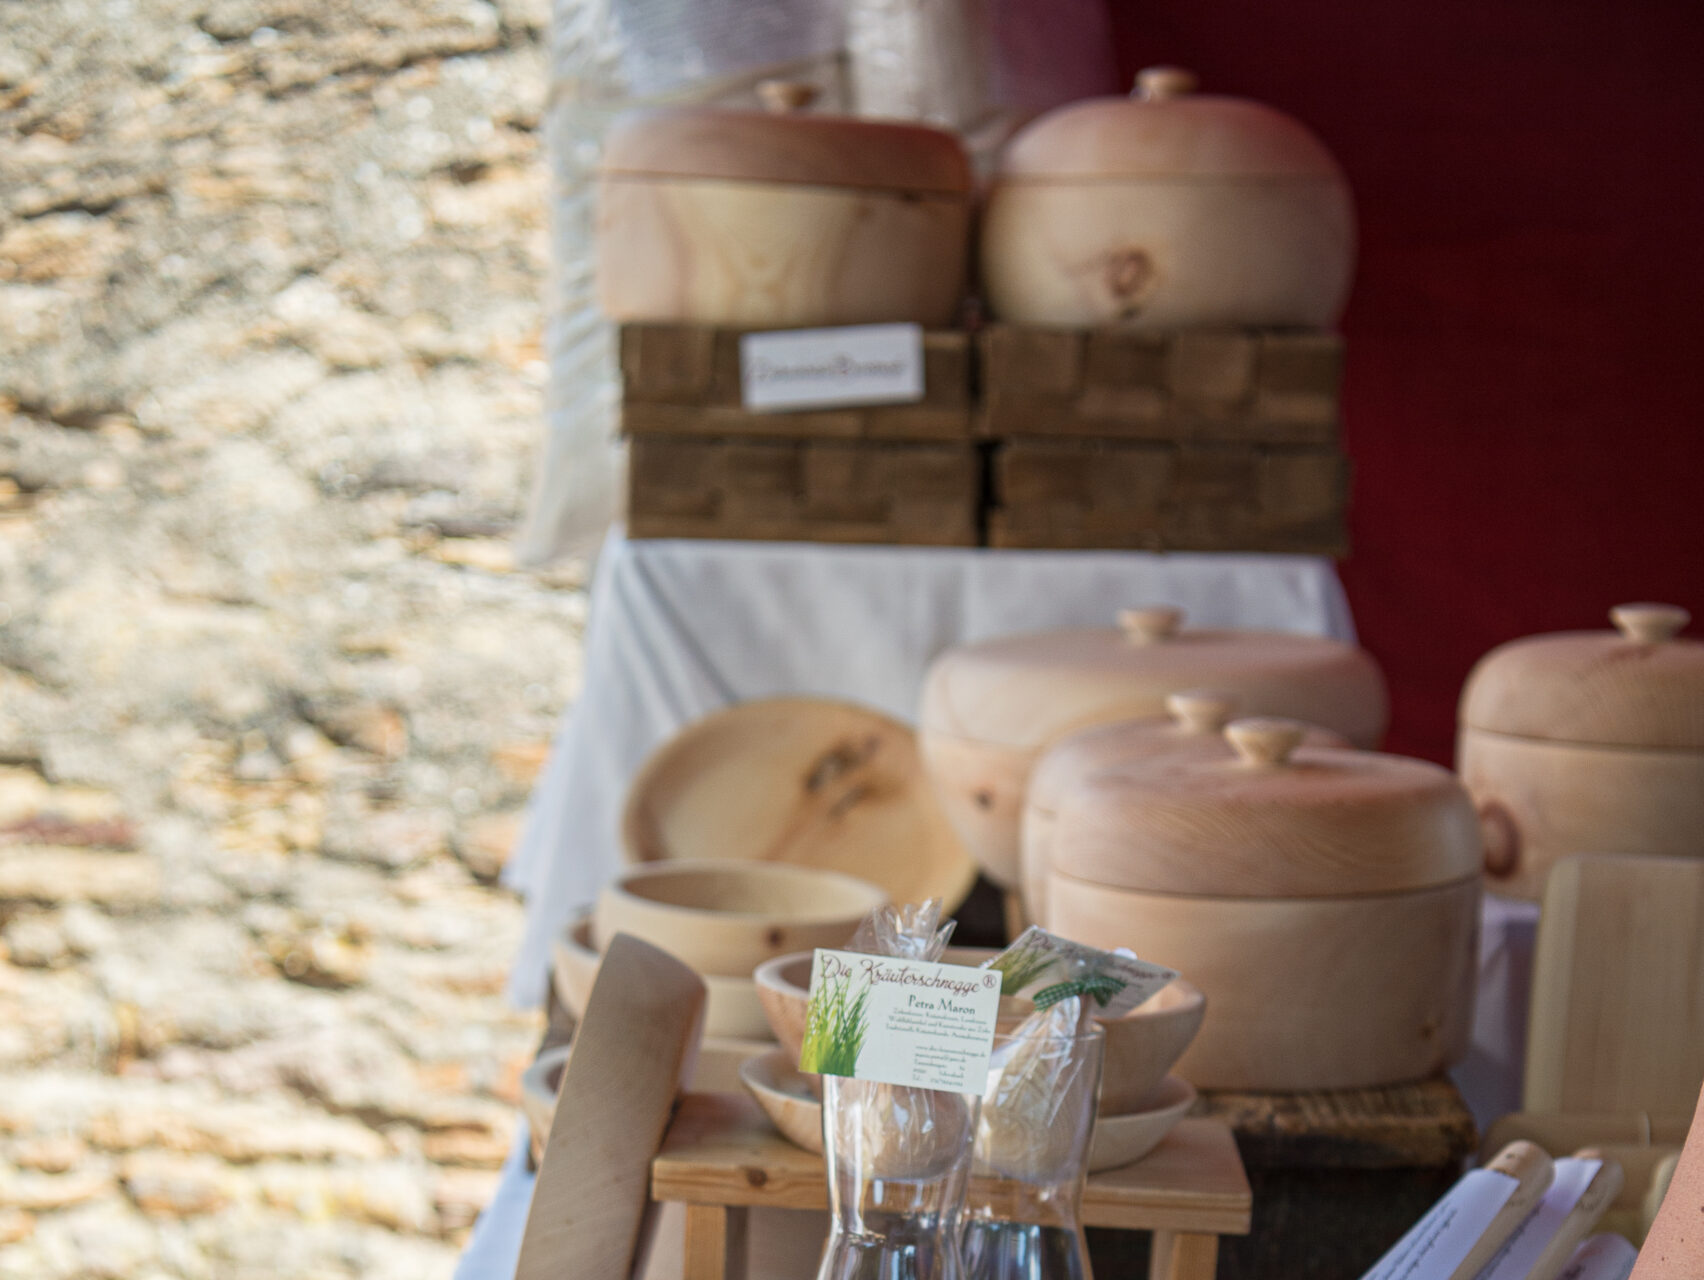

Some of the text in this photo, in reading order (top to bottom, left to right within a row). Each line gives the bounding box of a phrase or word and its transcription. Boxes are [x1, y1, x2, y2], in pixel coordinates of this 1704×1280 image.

[821, 954, 852, 978] Die
[860, 959, 980, 997] Kräuterschnegge
[908, 994, 975, 1014] Petra Maron
